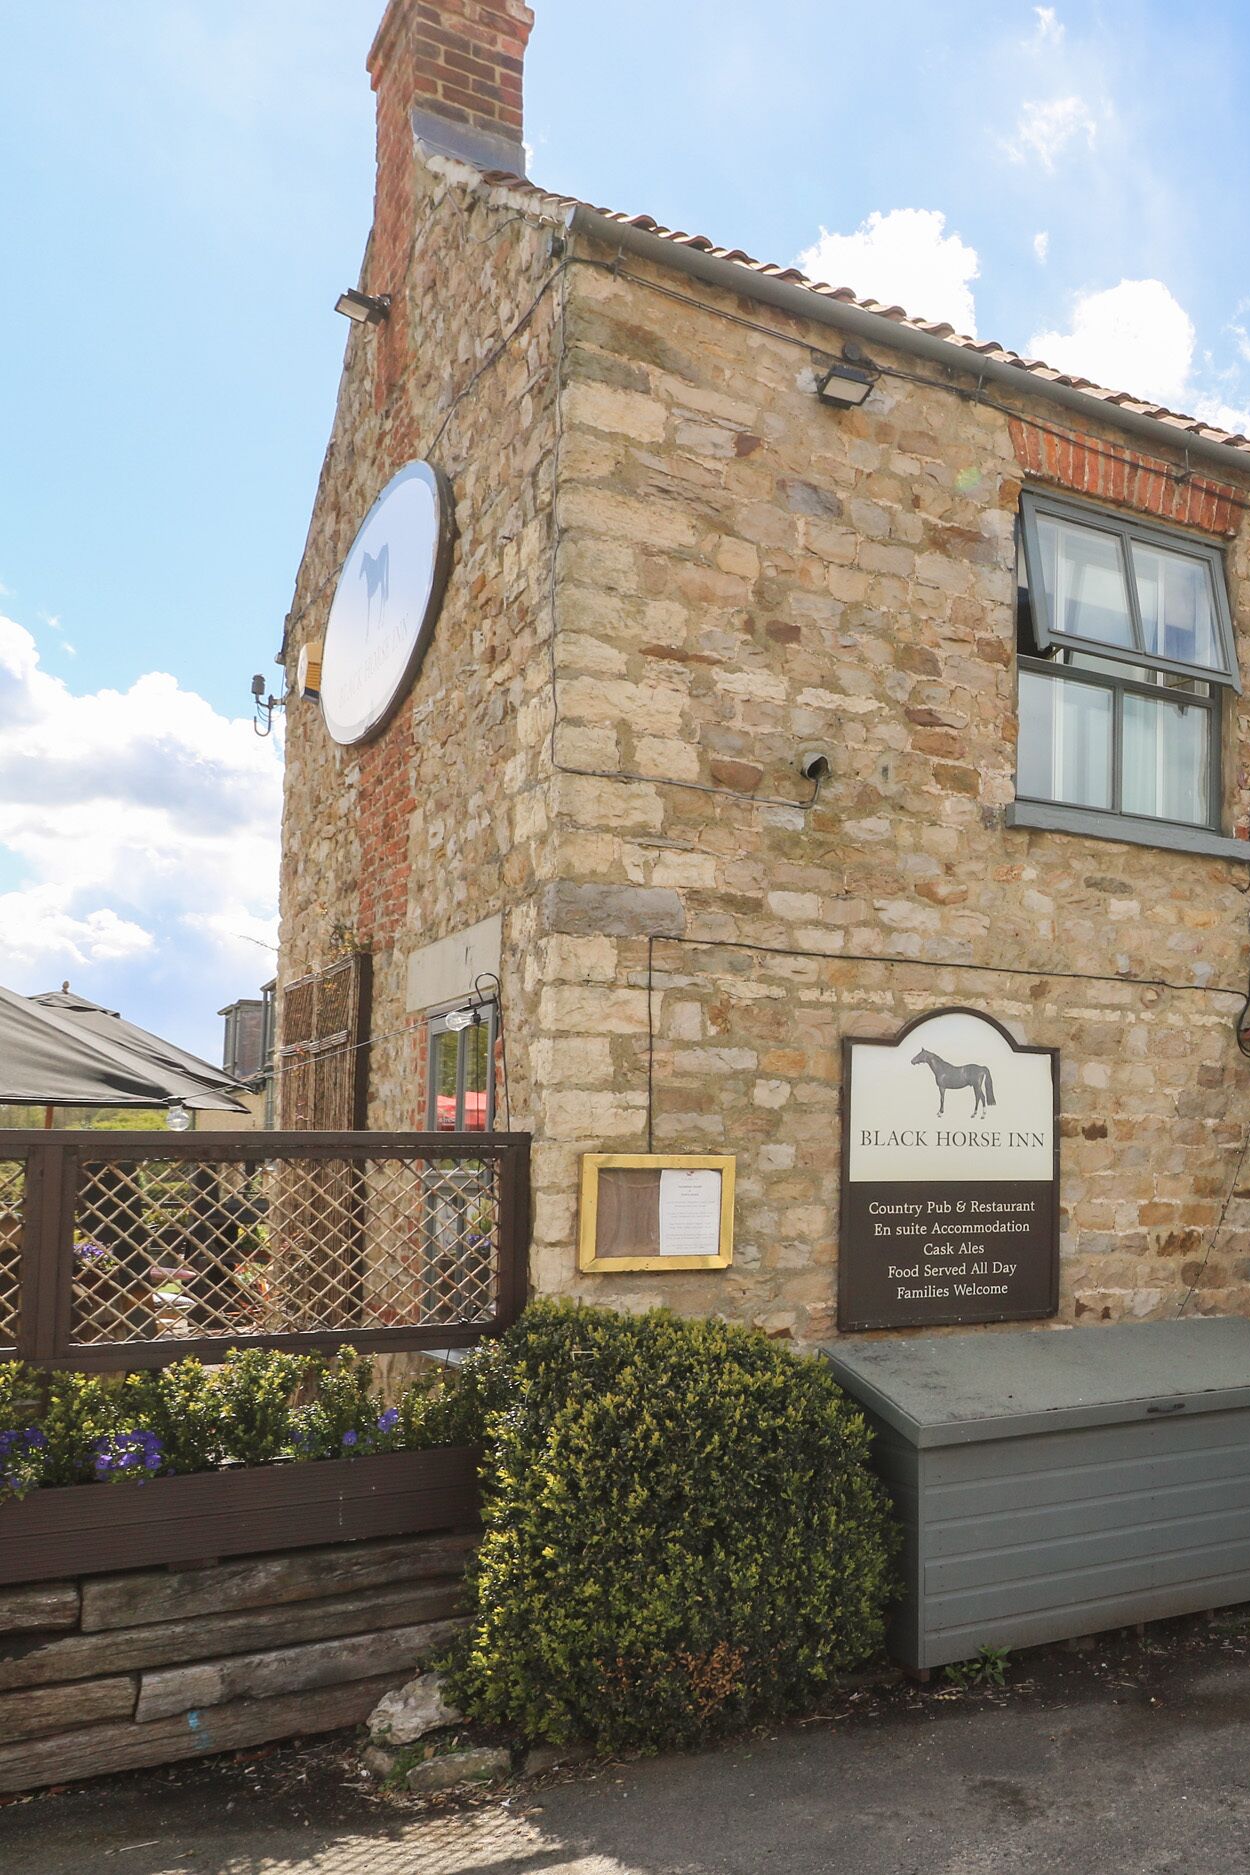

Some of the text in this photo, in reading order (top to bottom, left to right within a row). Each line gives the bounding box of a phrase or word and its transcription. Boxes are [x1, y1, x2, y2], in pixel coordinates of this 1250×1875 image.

[860, 1130, 1045, 1148] BLACK HORSE INN
[868, 1200, 1036, 1218] Country Pub & Restaurant
[874, 1219, 1030, 1236] En suite Accommodation
[923, 1241, 985, 1256] Cask Ales
[887, 1260, 1017, 1279] Food Served All Day
[897, 1282, 1009, 1300] Families Welcome
